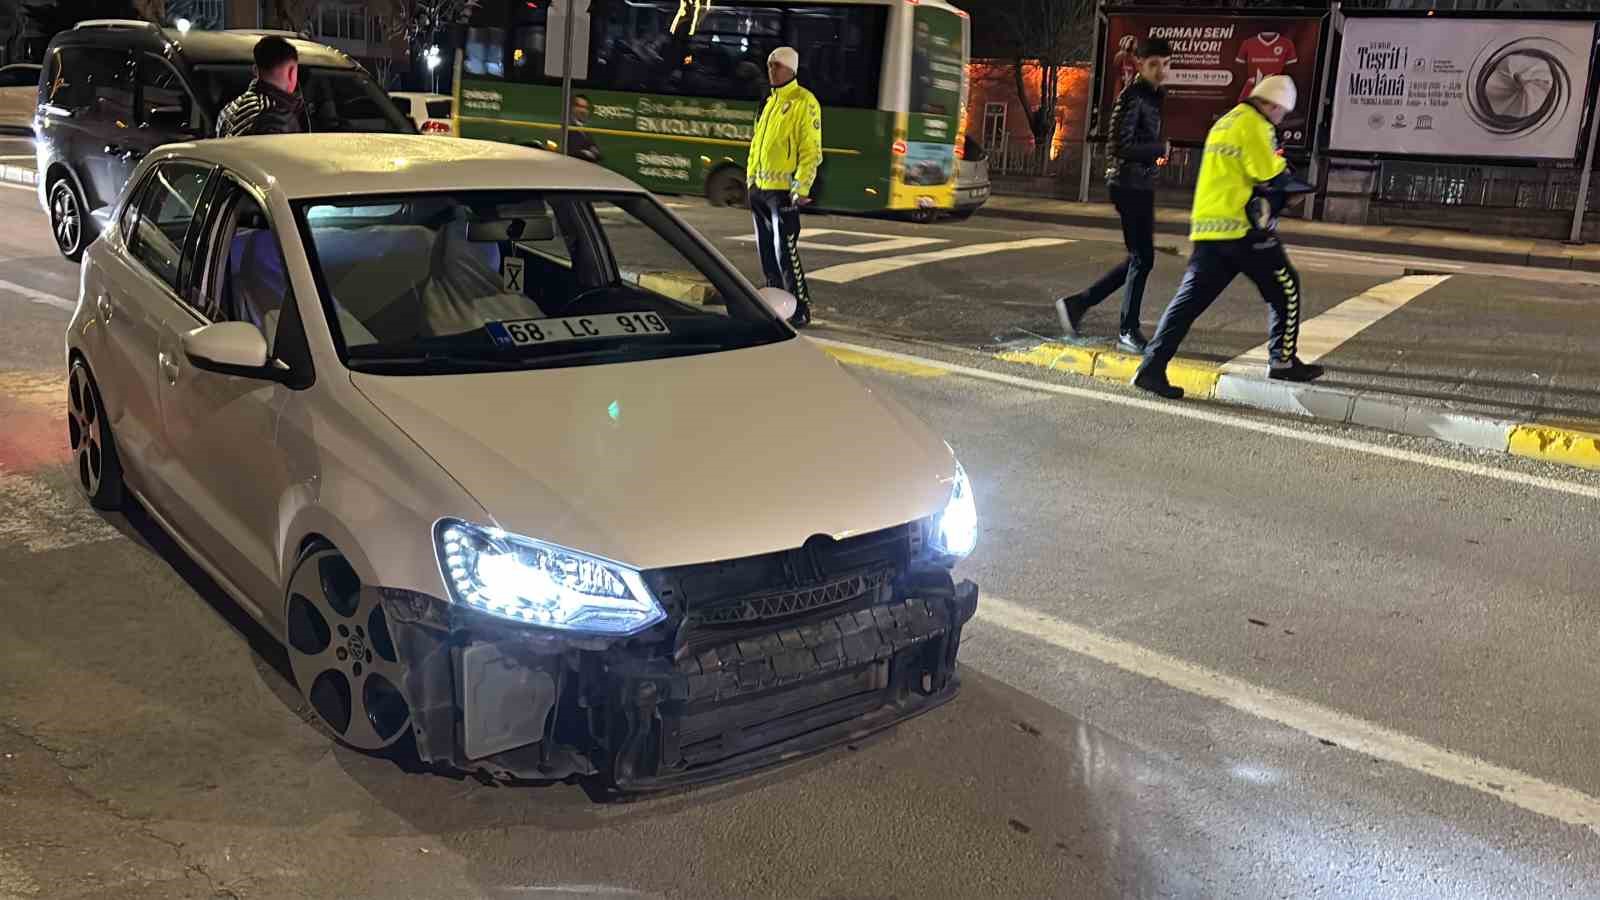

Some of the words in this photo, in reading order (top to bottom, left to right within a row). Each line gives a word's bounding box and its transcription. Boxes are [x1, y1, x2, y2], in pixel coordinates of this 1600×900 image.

[1149, 26, 1202, 39] FORMAN
[1203, 24, 1235, 39] SENİ
[507, 322, 545, 343] 68
[562, 318, 600, 337] LC
[616, 313, 666, 334] 919
